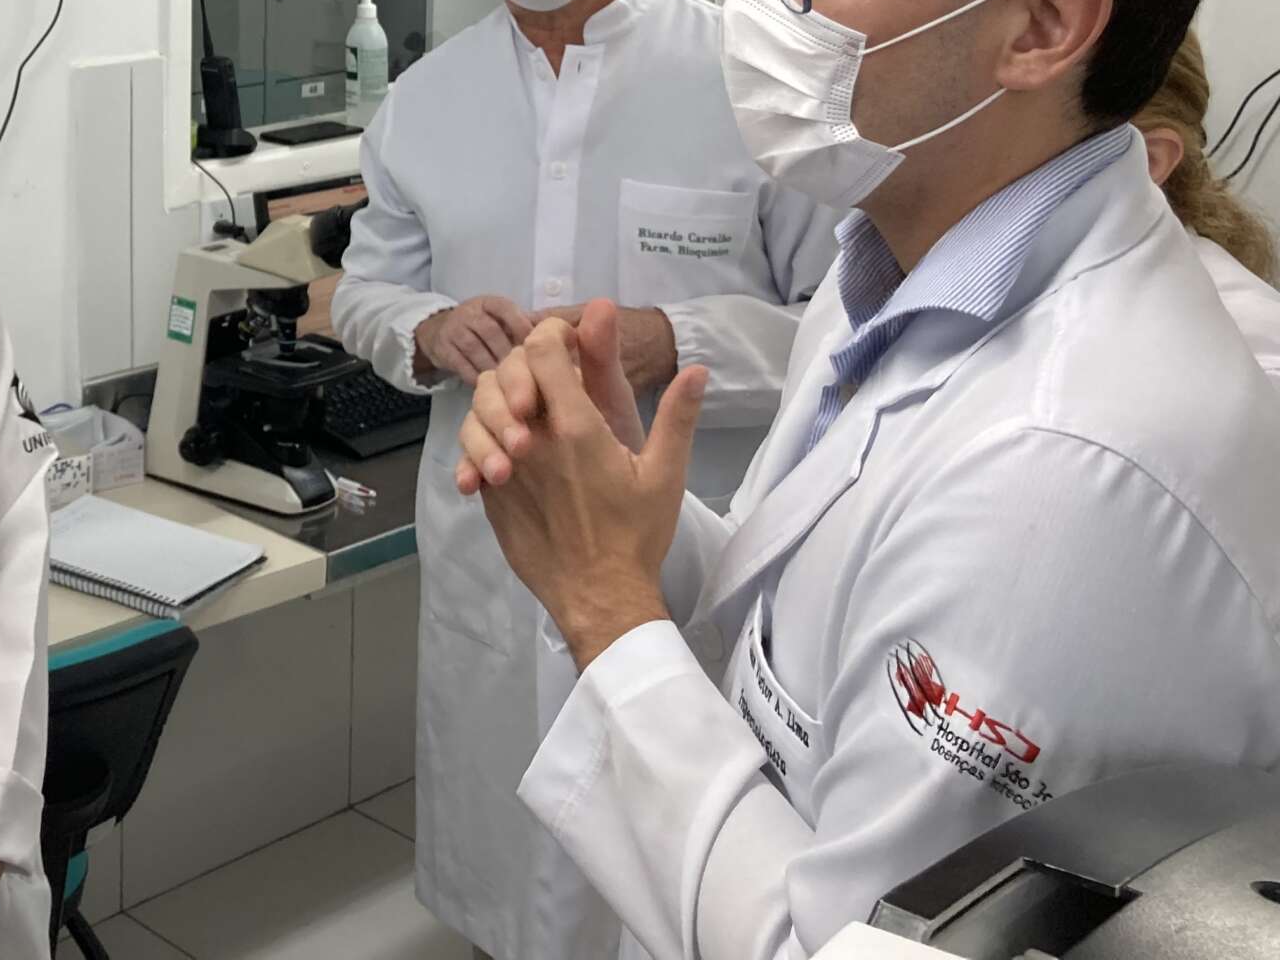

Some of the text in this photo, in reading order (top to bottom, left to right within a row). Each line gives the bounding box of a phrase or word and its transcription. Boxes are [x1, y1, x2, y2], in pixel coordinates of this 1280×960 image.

[638, 227, 733, 244] Ricardo Carvalho
[786, 708, 810, 748] Lima
[930, 737, 987, 782] Doenças
[936, 717, 1002, 770] Hospital
[1000, 761, 1030, 791] São
